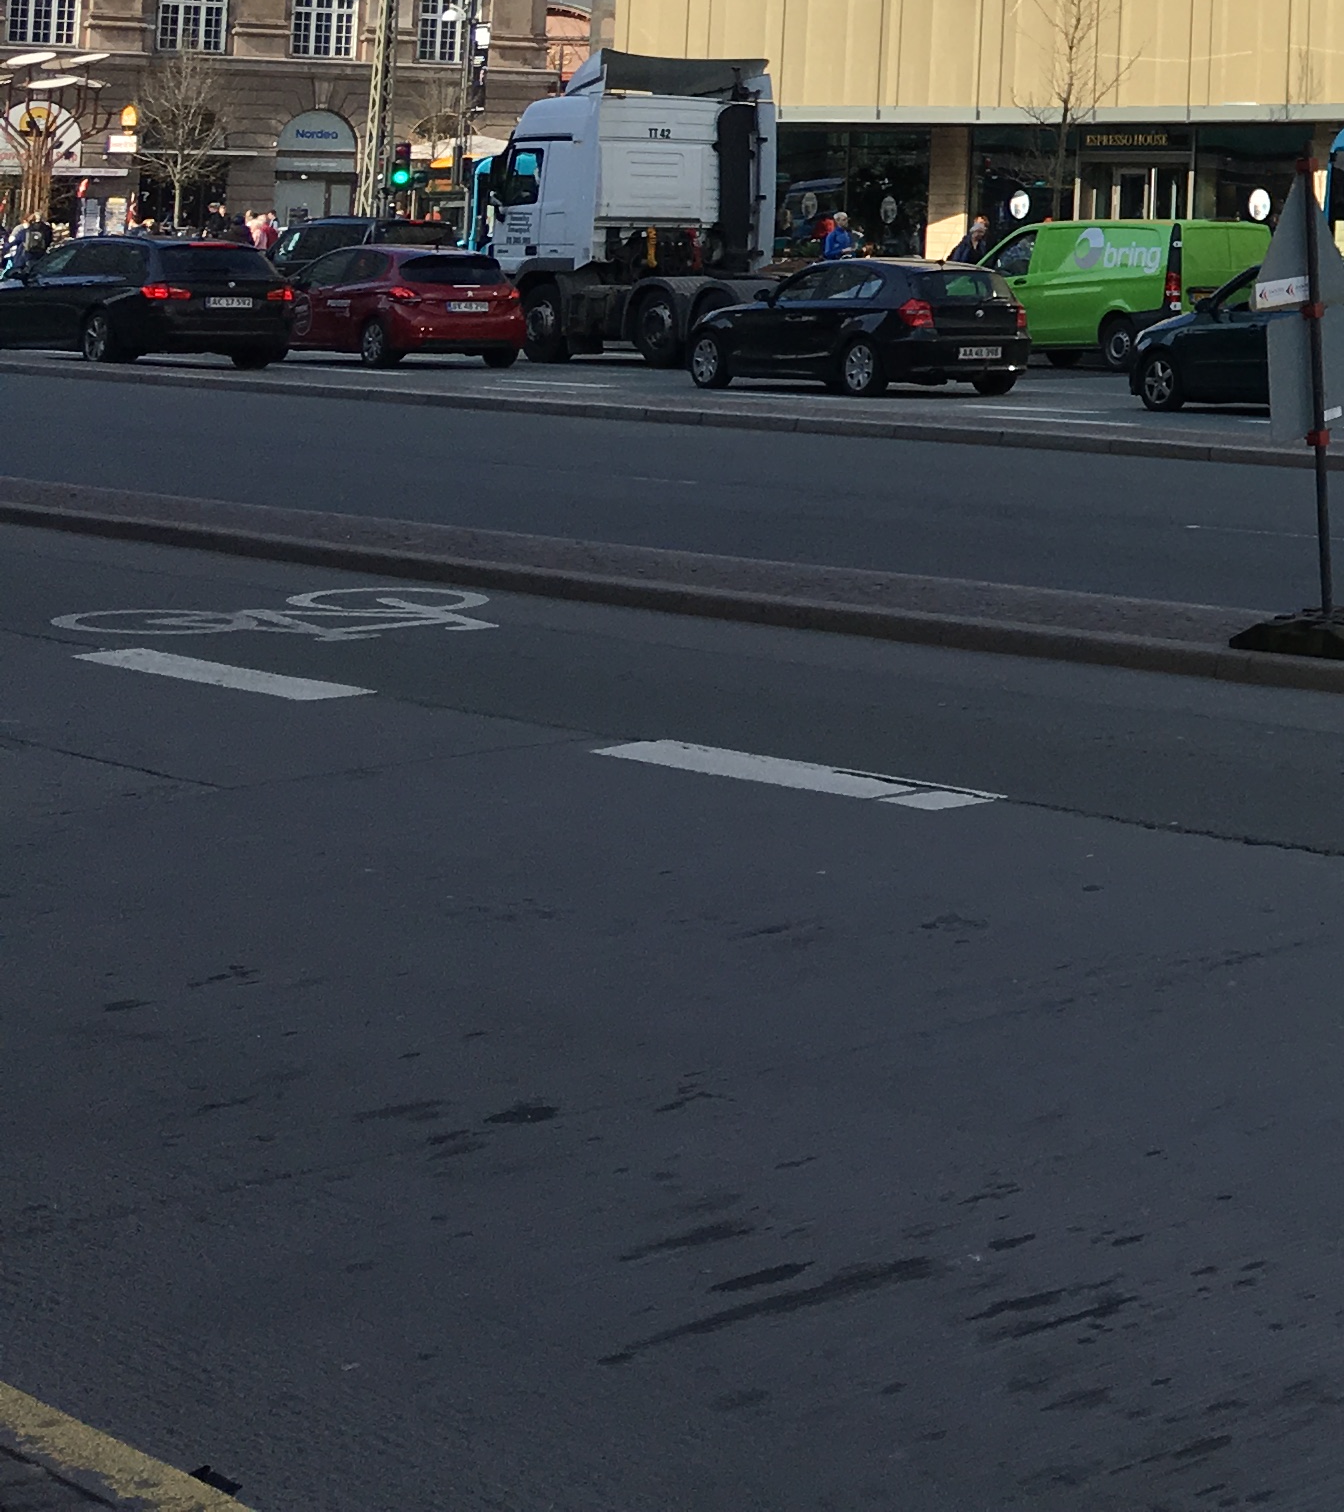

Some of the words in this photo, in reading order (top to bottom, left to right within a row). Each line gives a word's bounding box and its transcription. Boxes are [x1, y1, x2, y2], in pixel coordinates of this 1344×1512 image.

[295, 129, 339, 140] Nordea
[1085, 134, 1132, 147] ESPRESSO
[1134, 134, 1169, 146] HOUSE
[1103, 241, 1162, 274] bring
